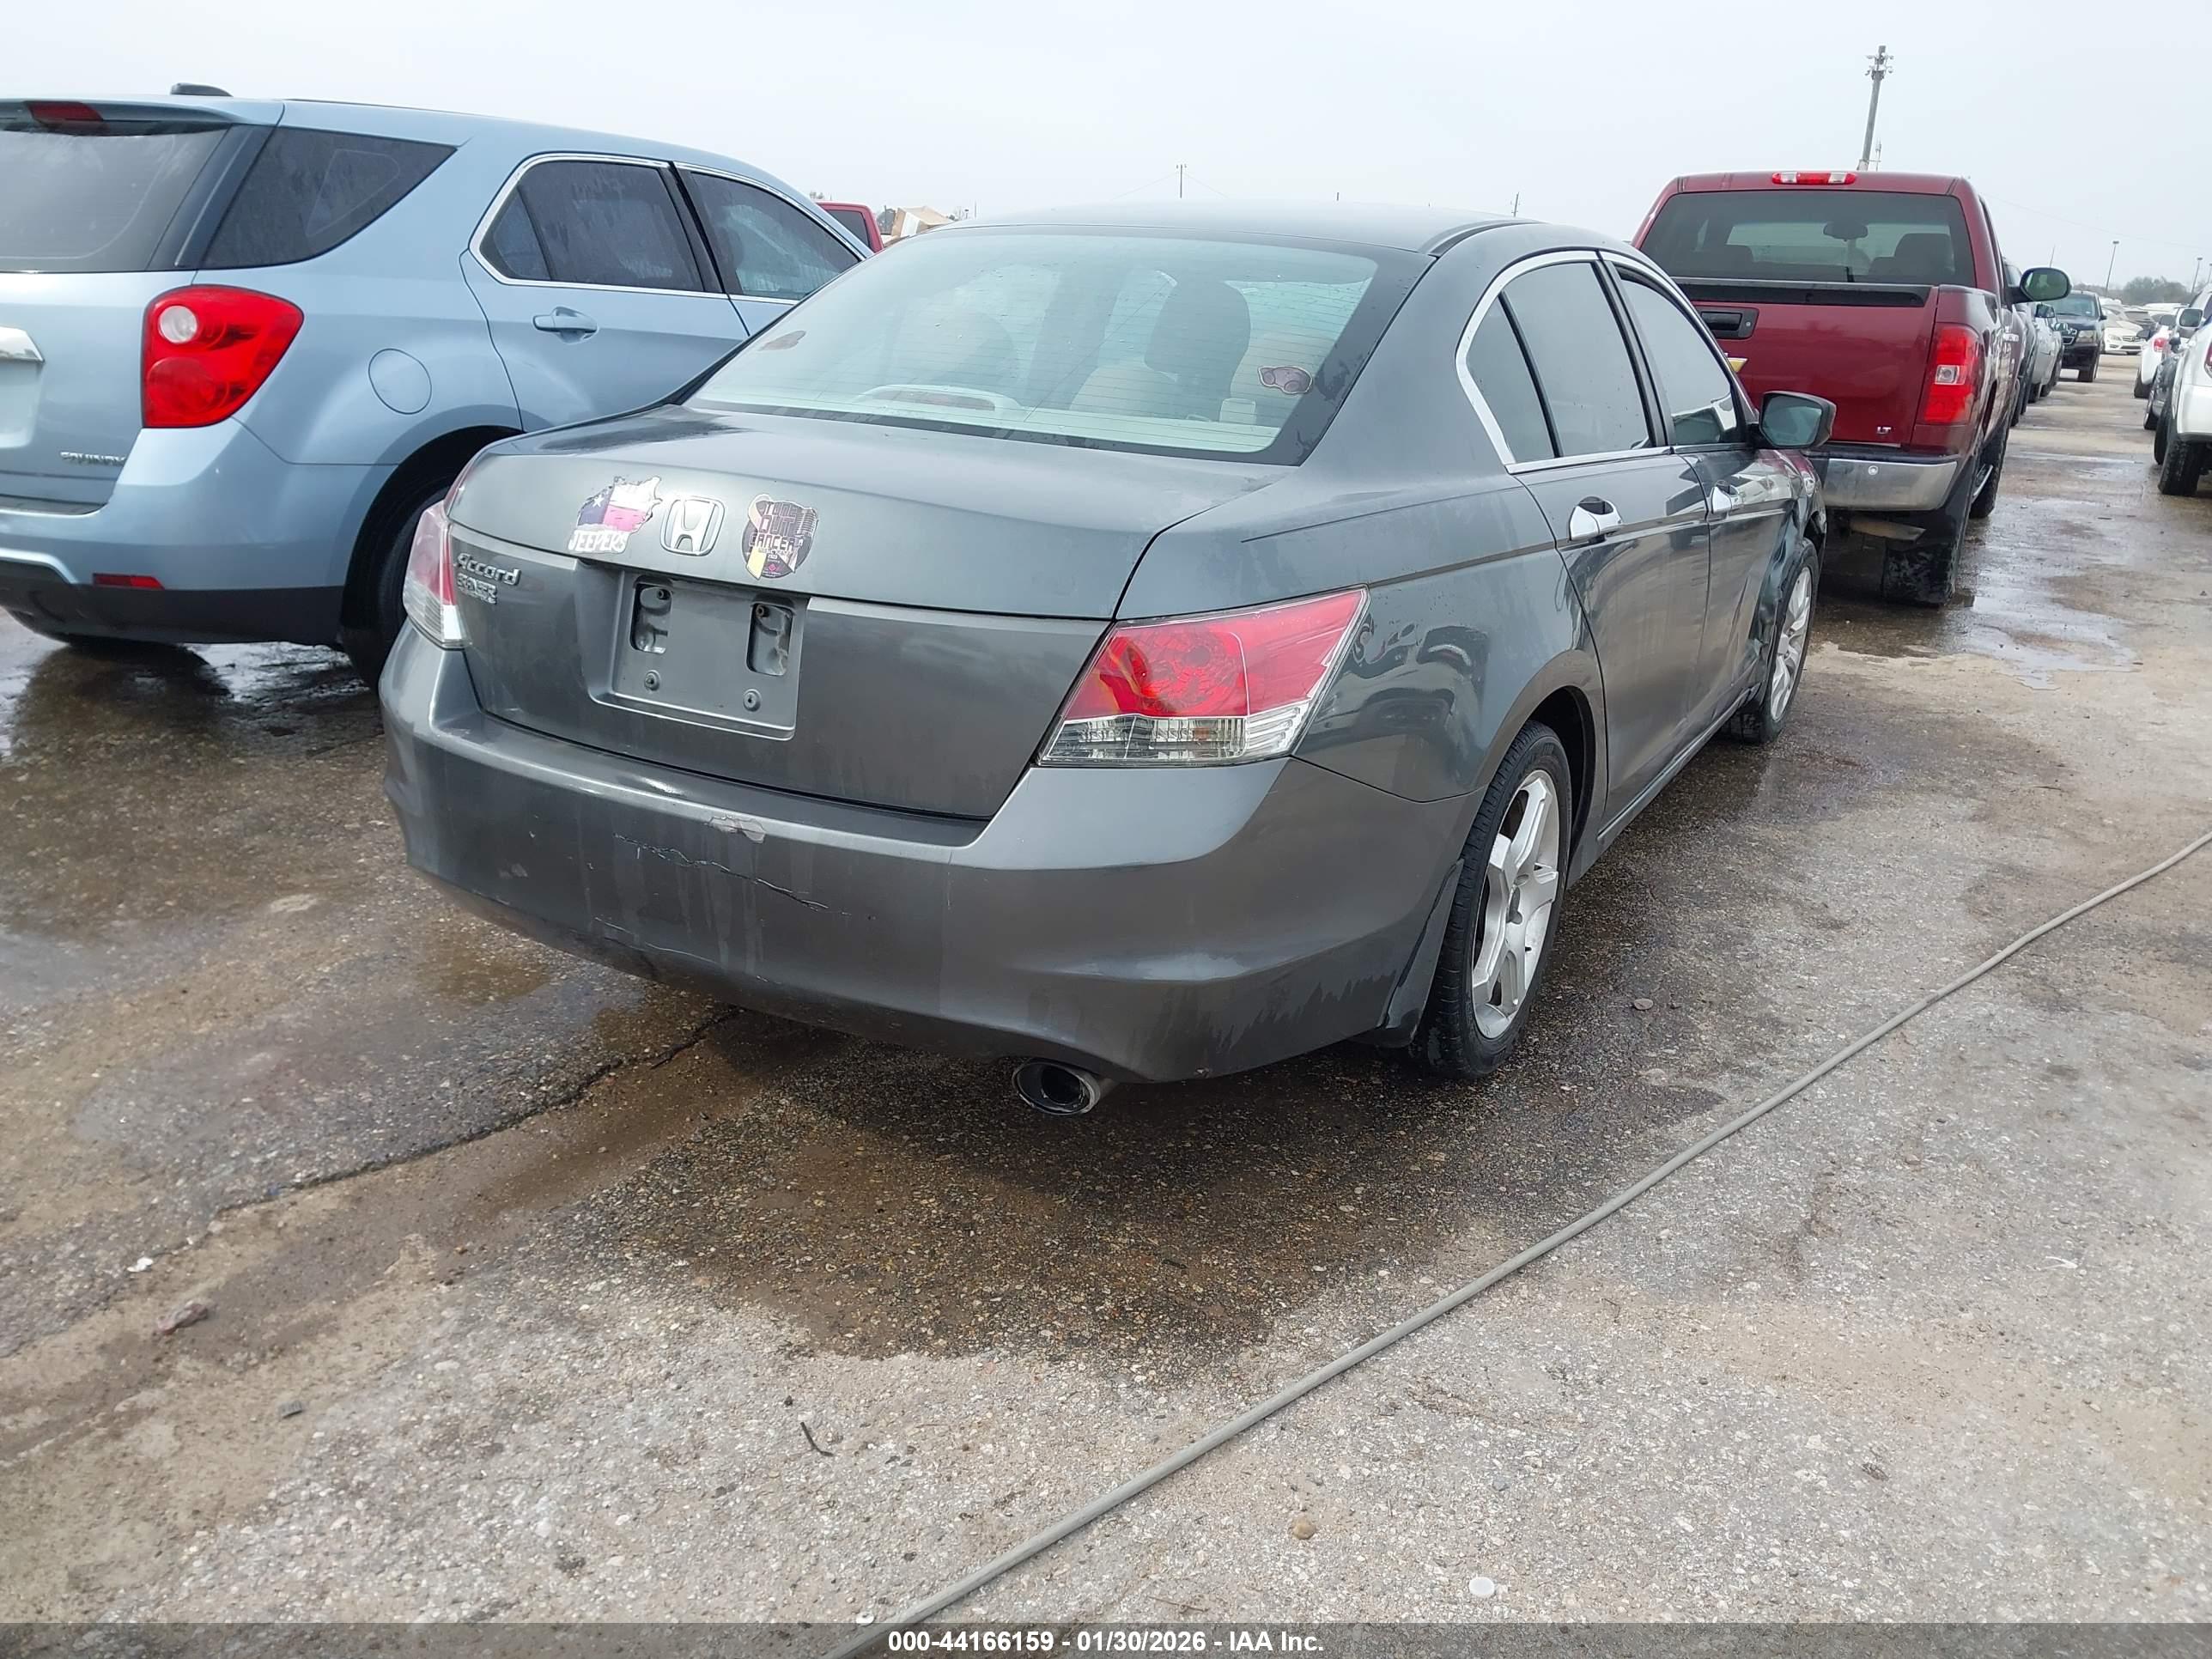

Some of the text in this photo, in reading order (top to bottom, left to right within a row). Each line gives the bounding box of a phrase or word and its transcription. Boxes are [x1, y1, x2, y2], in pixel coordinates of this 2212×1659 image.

[1876, 426, 1892, 434] LT
[758, 514, 797, 538] OUT
[568, 529, 627, 553] JEEPERS
[455, 552, 522, 586] Accord
